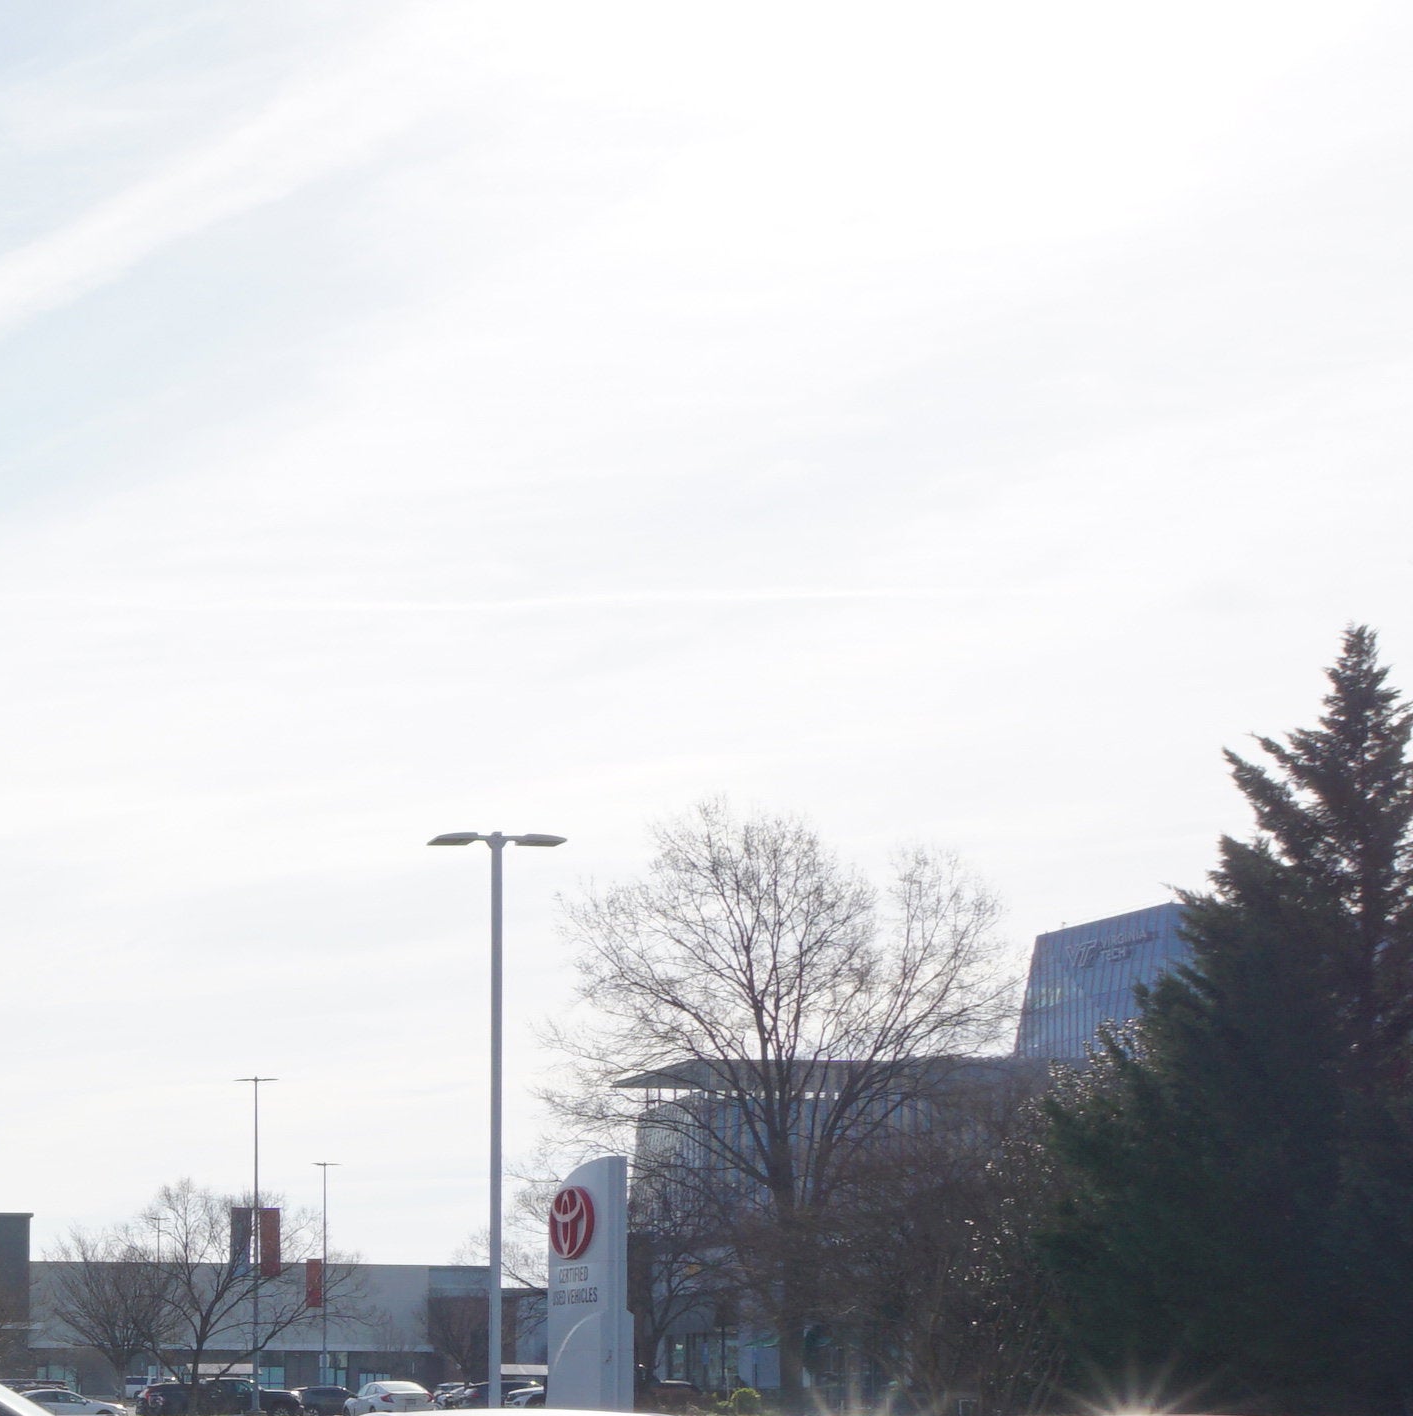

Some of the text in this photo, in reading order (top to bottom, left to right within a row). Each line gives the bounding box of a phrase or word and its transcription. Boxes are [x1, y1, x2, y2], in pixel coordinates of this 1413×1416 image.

[1100, 929, 1147, 948] VIRGINIA
[1100, 947, 1126, 961] TECH
[559, 1266, 589, 1283] CERTIFIED
[553, 1287, 598, 1306] USED VEHICLES
